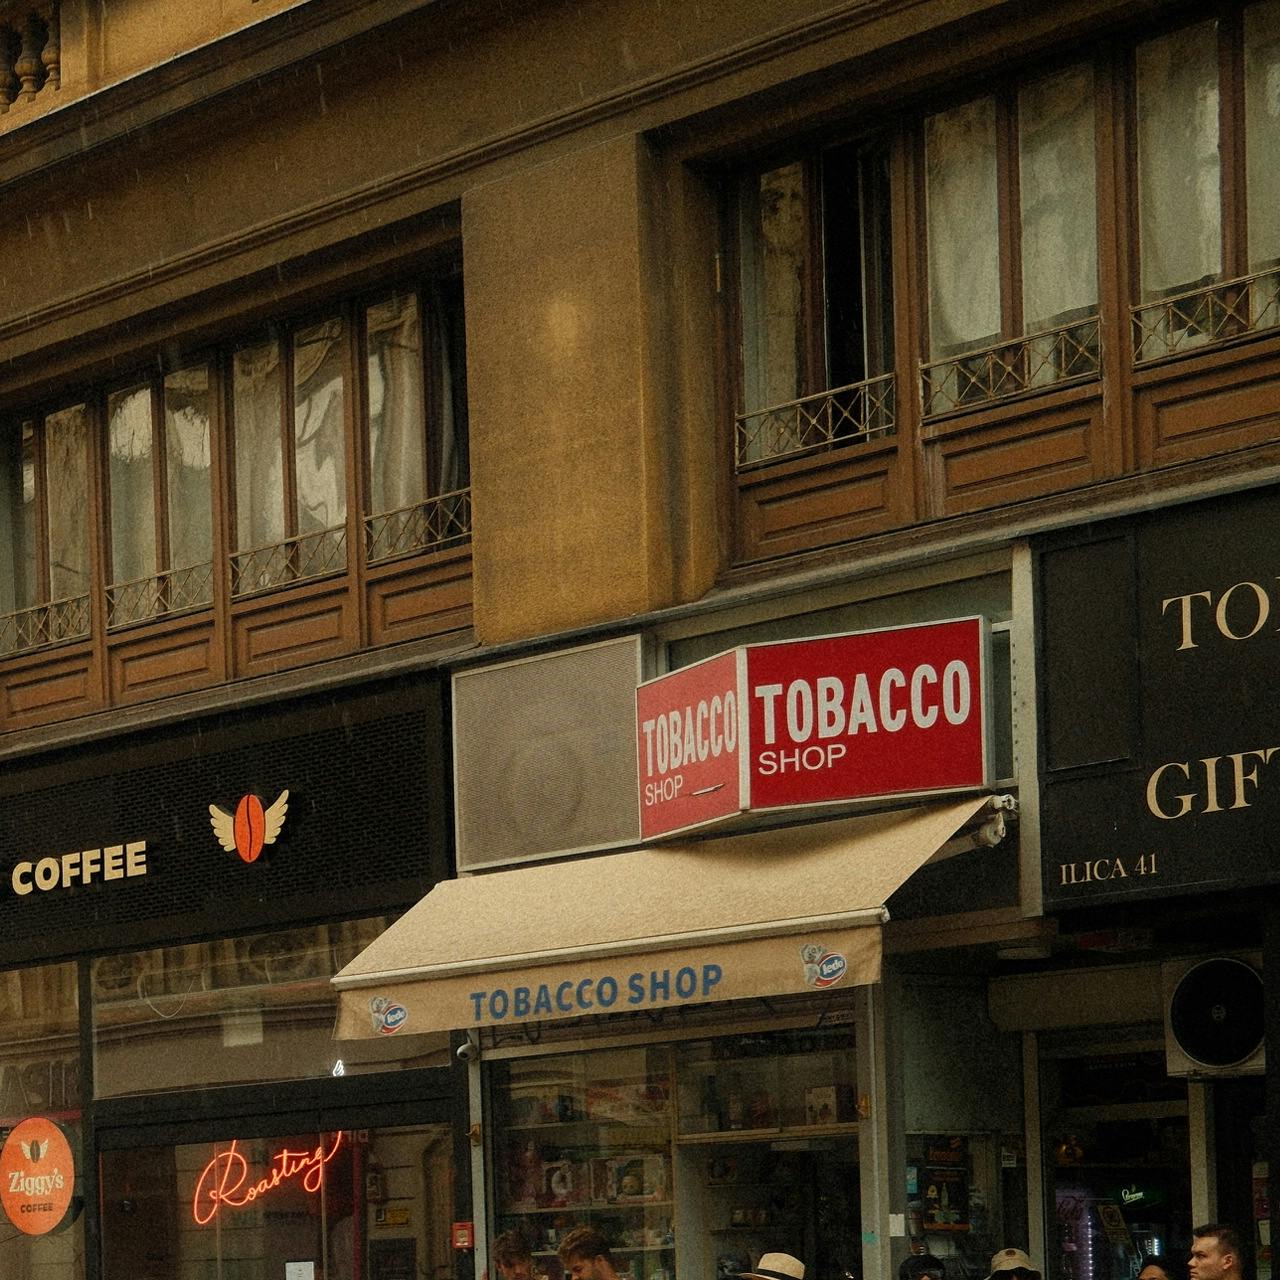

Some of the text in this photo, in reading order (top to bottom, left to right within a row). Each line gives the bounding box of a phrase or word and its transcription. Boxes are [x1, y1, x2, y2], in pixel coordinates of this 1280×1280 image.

[1161, 576, 1280, 651] TO
[755, 660, 971, 745] TOBACCO
[643, 690, 739, 777] TOBACCO
[758, 743, 847, 776] SHOP
[645, 774, 684, 807] SHOP
[11, 840, 148, 896] COFFEE
[1059, 853, 1159, 887] ILICA 41
[822, 960, 844, 975] ledo
[470, 963, 724, 1022] TOBACCO SHOP
[8, 1167, 65, 1196] Ziggy's
[193, 1131, 342, 1225] Roasting
[20, 1203, 54, 1214] COFFEE
